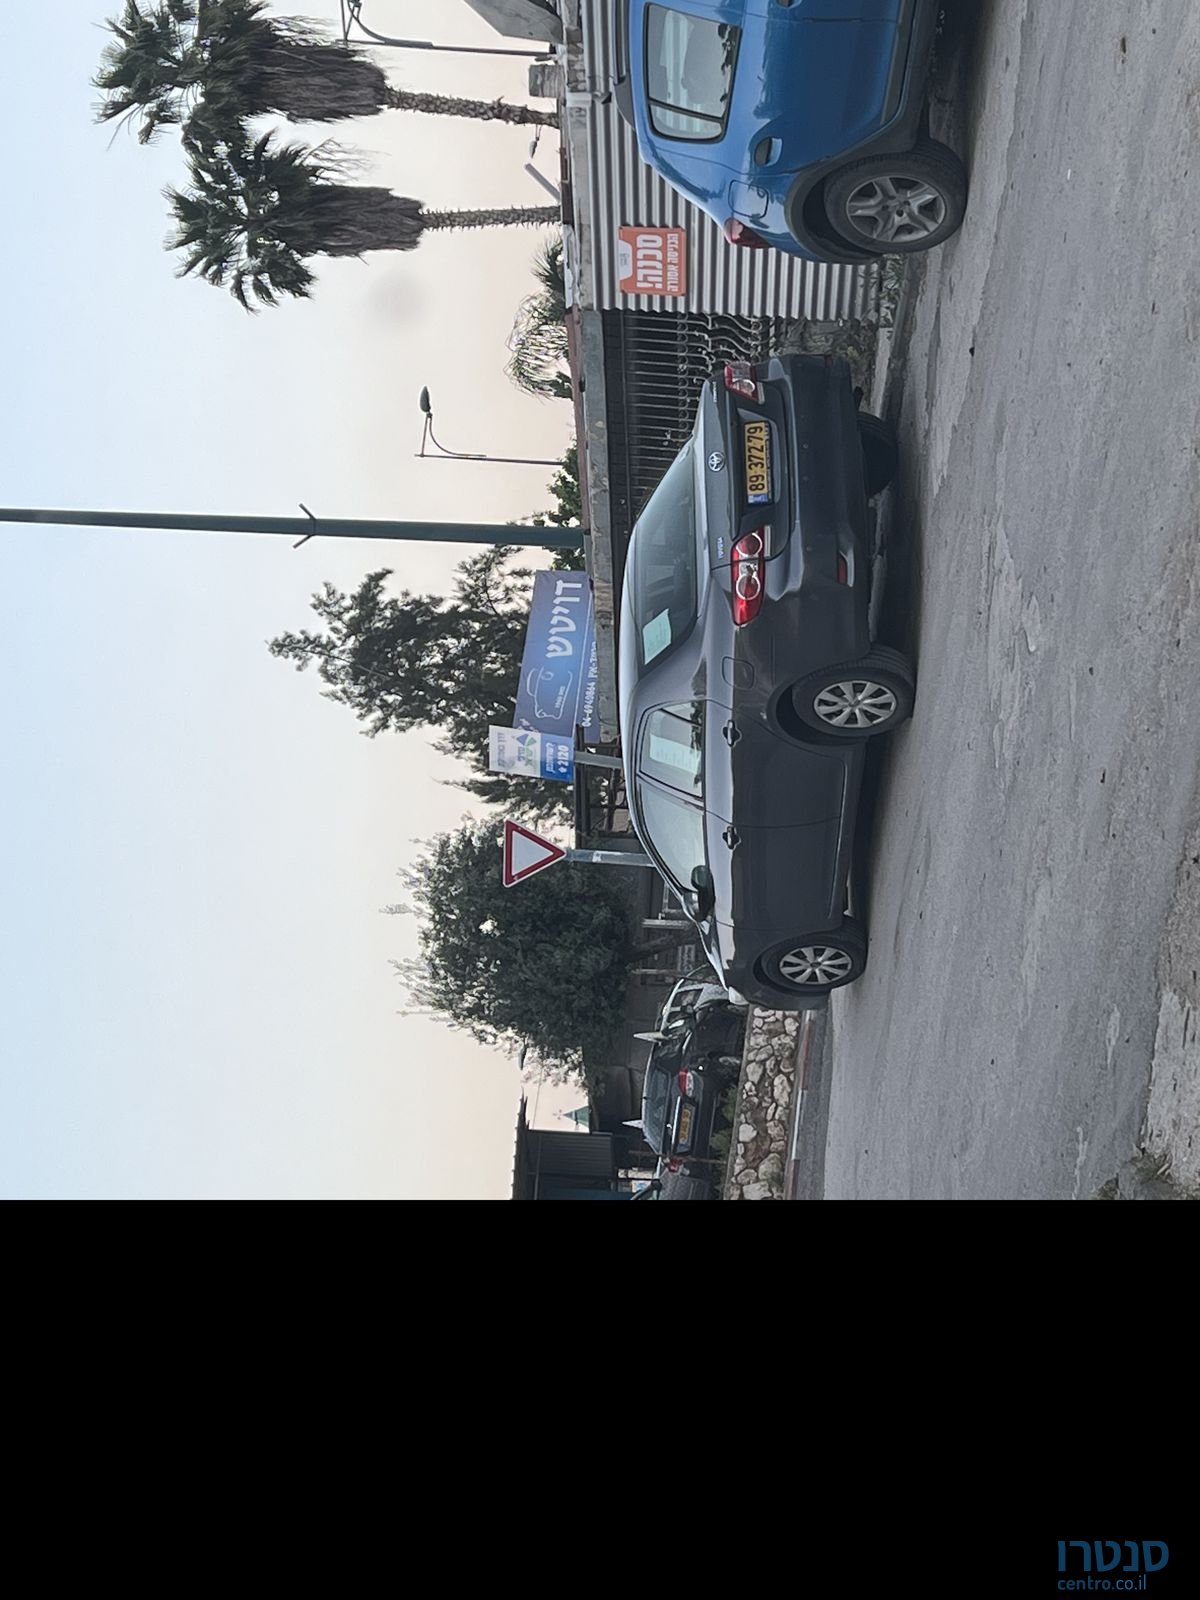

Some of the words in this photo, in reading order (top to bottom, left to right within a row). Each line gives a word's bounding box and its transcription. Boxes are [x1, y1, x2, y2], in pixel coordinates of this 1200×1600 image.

[636, 234, 663, 289] סכנה!
[666, 233, 679, 264] הכניסה
[666, 264, 679, 292] אסורה
[545, 579, 583, 658] דויטש
